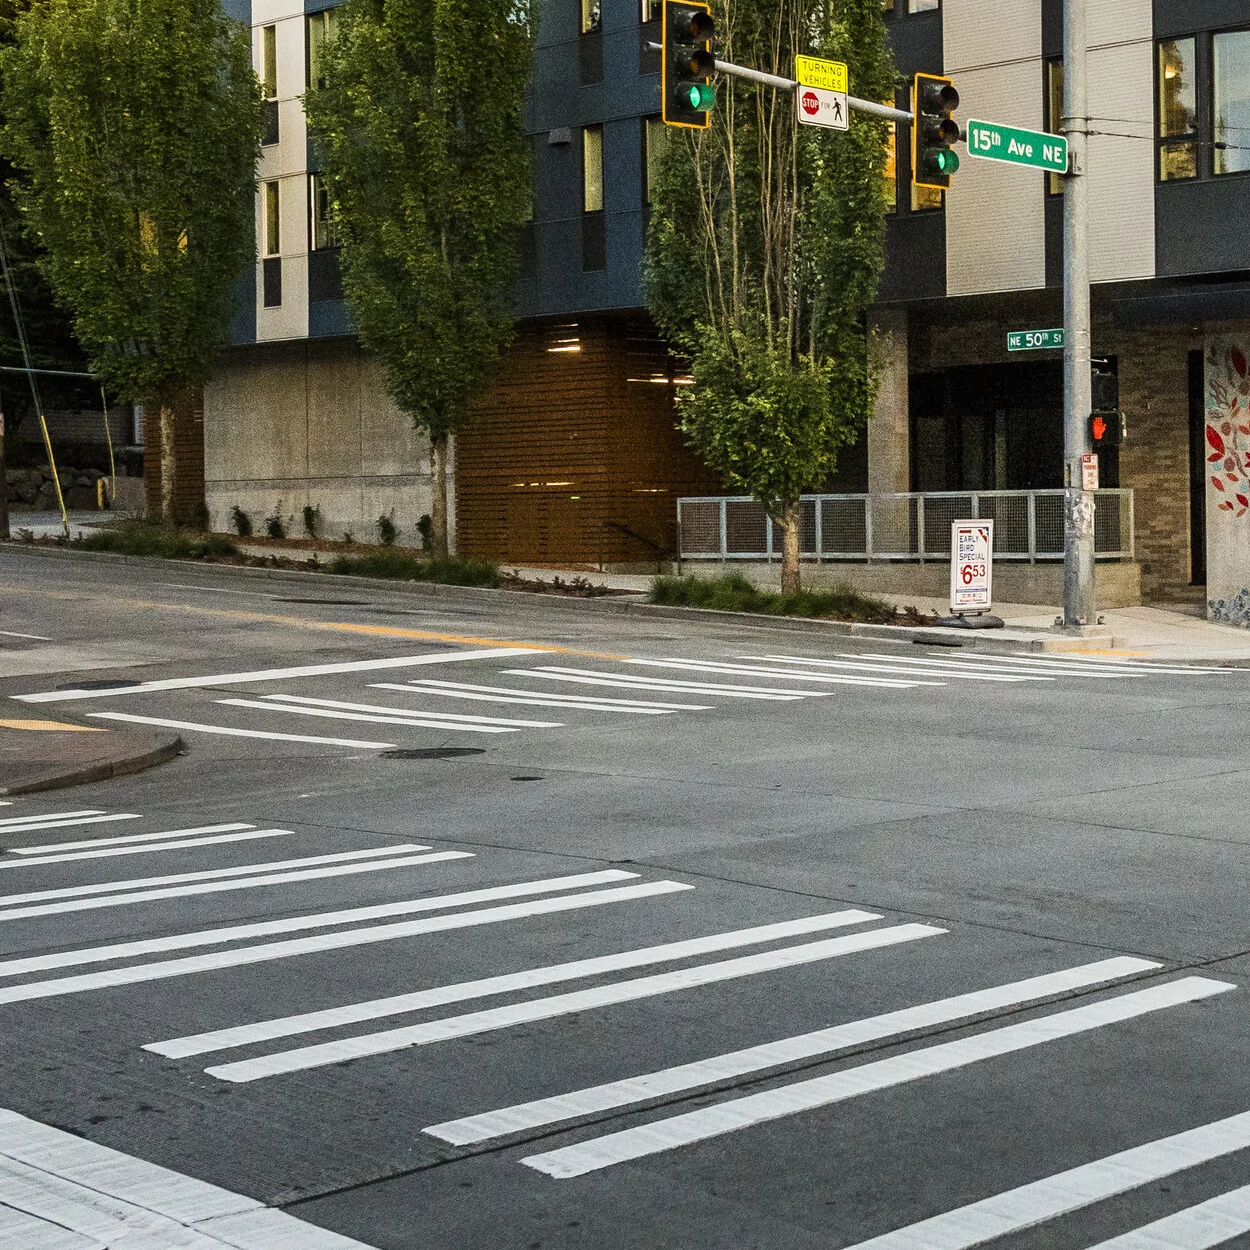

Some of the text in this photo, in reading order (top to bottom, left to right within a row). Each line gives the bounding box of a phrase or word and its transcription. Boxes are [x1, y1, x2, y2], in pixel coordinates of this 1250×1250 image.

[803, 61, 842, 76] TURNING
[804, 74, 842, 89] VEHICLES
[802, 97, 819, 109] STOP
[973, 128, 1063, 163] 15th Ave NE
[1010, 336, 1021, 346] NE
[1025, 332, 1049, 347] 50th
[959, 535, 979, 543] EARLY
[959, 544, 975, 552] BIRD
[959, 553, 985, 561] SPECIAL
